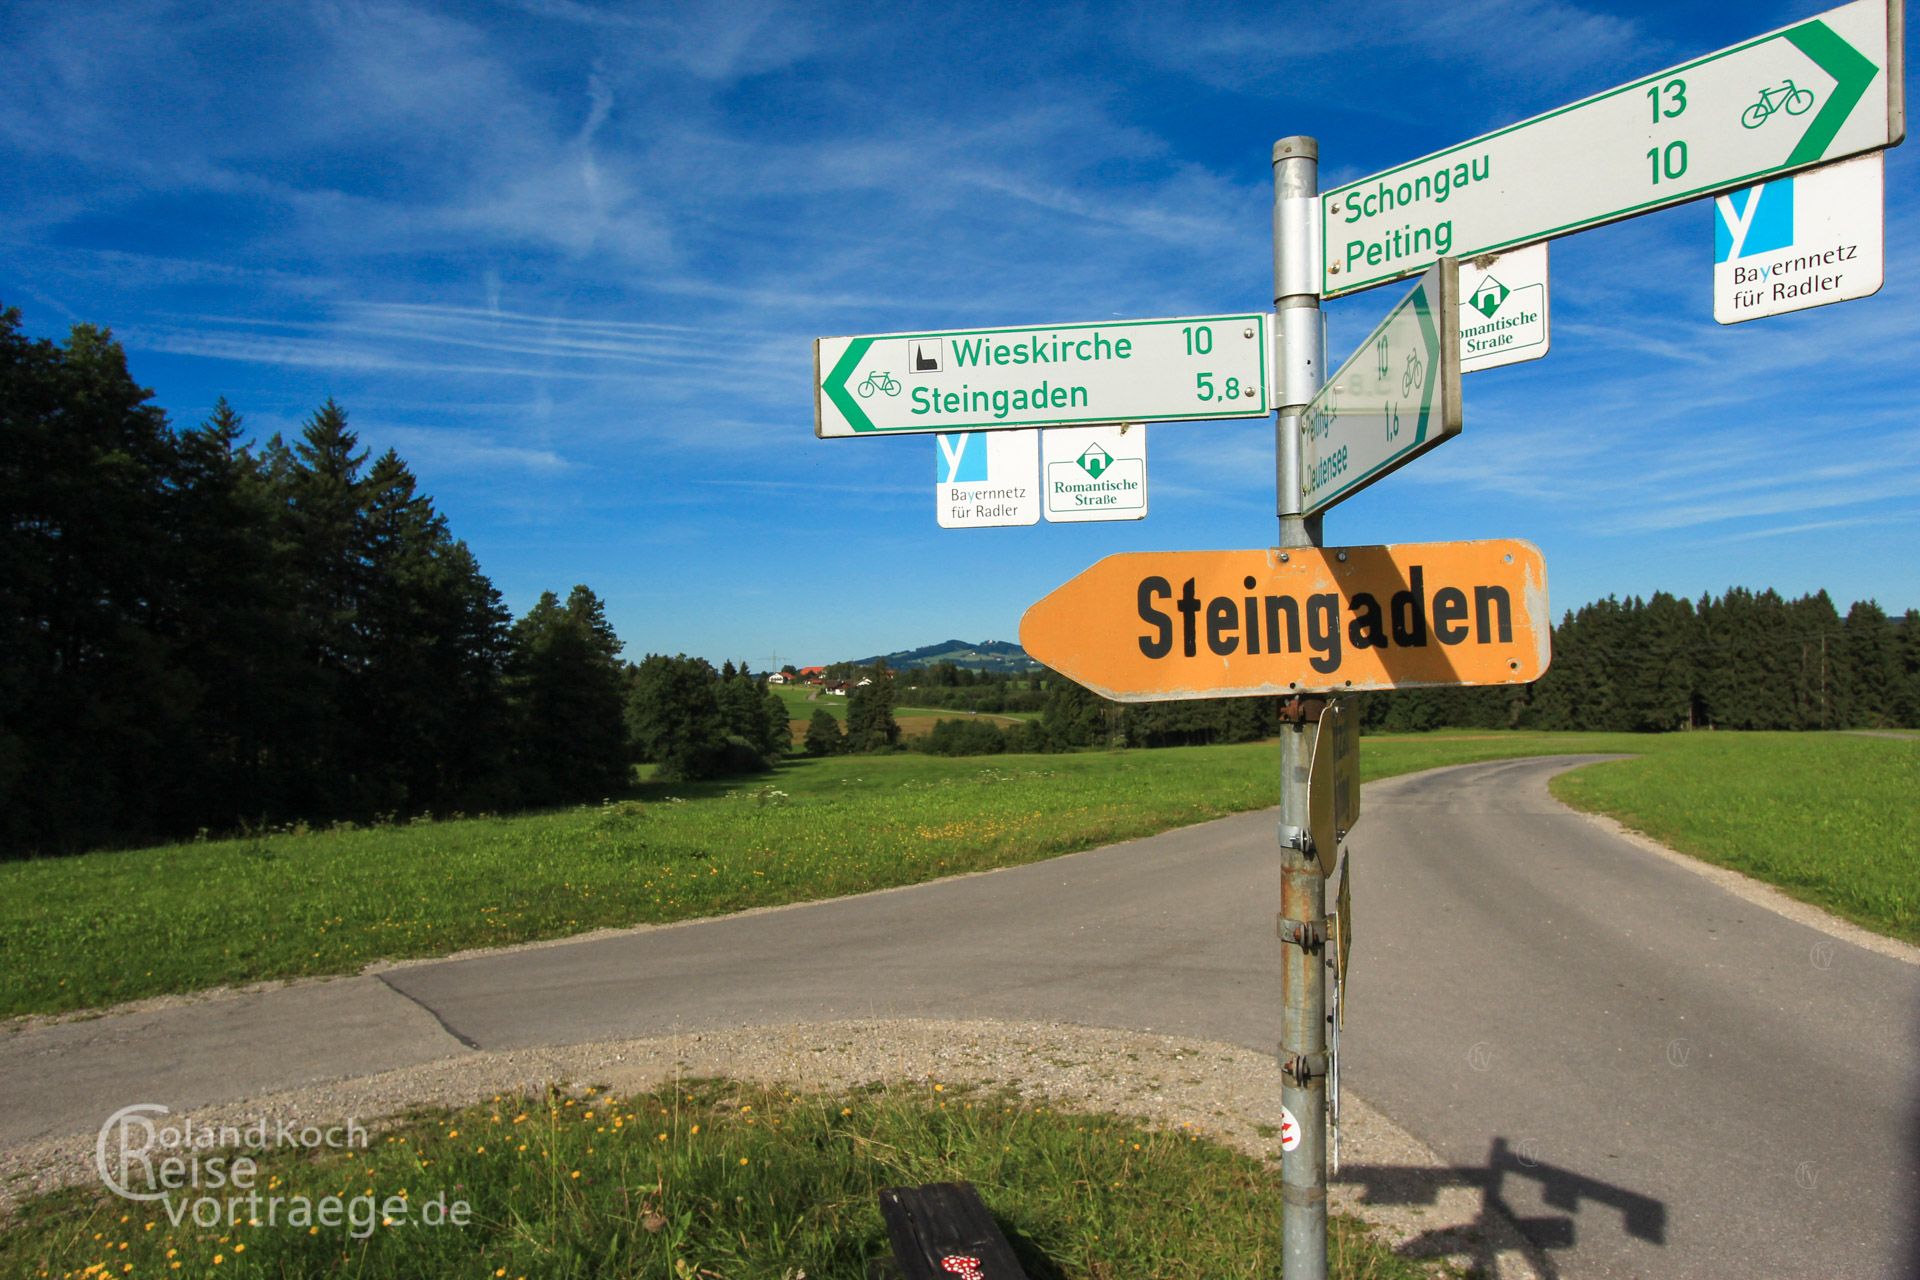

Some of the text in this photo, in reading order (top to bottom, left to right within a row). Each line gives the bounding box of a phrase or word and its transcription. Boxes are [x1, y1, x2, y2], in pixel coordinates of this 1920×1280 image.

[1646, 78, 1687, 123] 13
[1647, 140, 1688, 185] 10
[1344, 154, 1490, 224] Schongau
[1346, 217, 1453, 273] Peiting
[1734, 245, 1857, 285] Bayernnetz
[1733, 273, 1843, 309] für Radler
[1459, 311, 1538, 339] omantische
[1466, 334, 1513, 353] Straße
[951, 326, 1213, 368] Wieskirche 10
[1376, 335, 1389, 382] 10
[911, 372, 1240, 419] Steingaden 5,8
[951, 487, 1026, 503] Bayernnetz
[1054, 480, 1139, 494] Romantische
[1074, 495, 1118, 507] Straße
[951, 504, 1019, 519] für Radler
[1137, 565, 1512, 674] Steingaden
